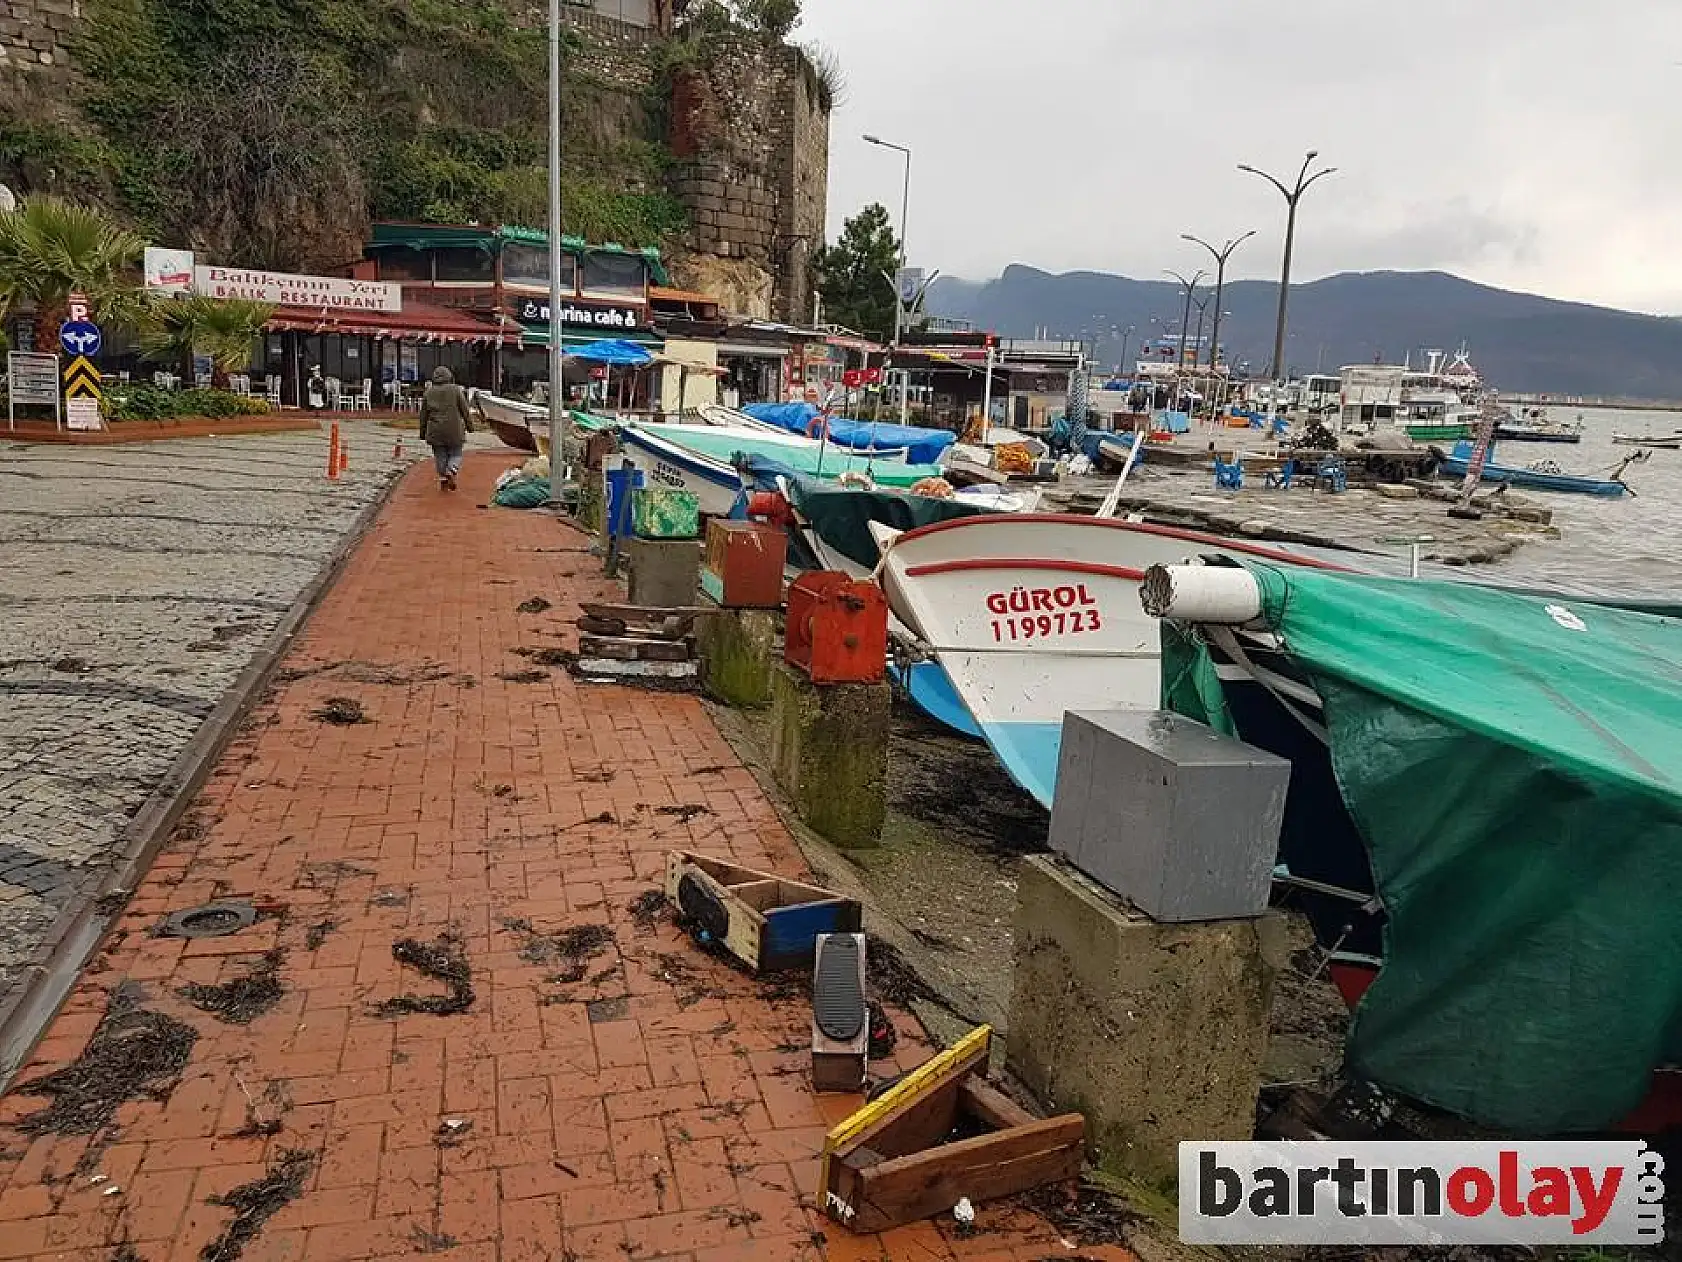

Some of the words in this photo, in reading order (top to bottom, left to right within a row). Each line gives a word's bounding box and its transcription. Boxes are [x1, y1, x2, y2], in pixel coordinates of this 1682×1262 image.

[216, 286, 266, 298] BALIK
[280, 291, 385, 309] RESTAURANT
[349, 281, 387, 295] Yeri
[594, 308, 624, 326] cafe
[986, 583, 1096, 615] GÜROL
[990, 609, 1101, 642] 1199723
